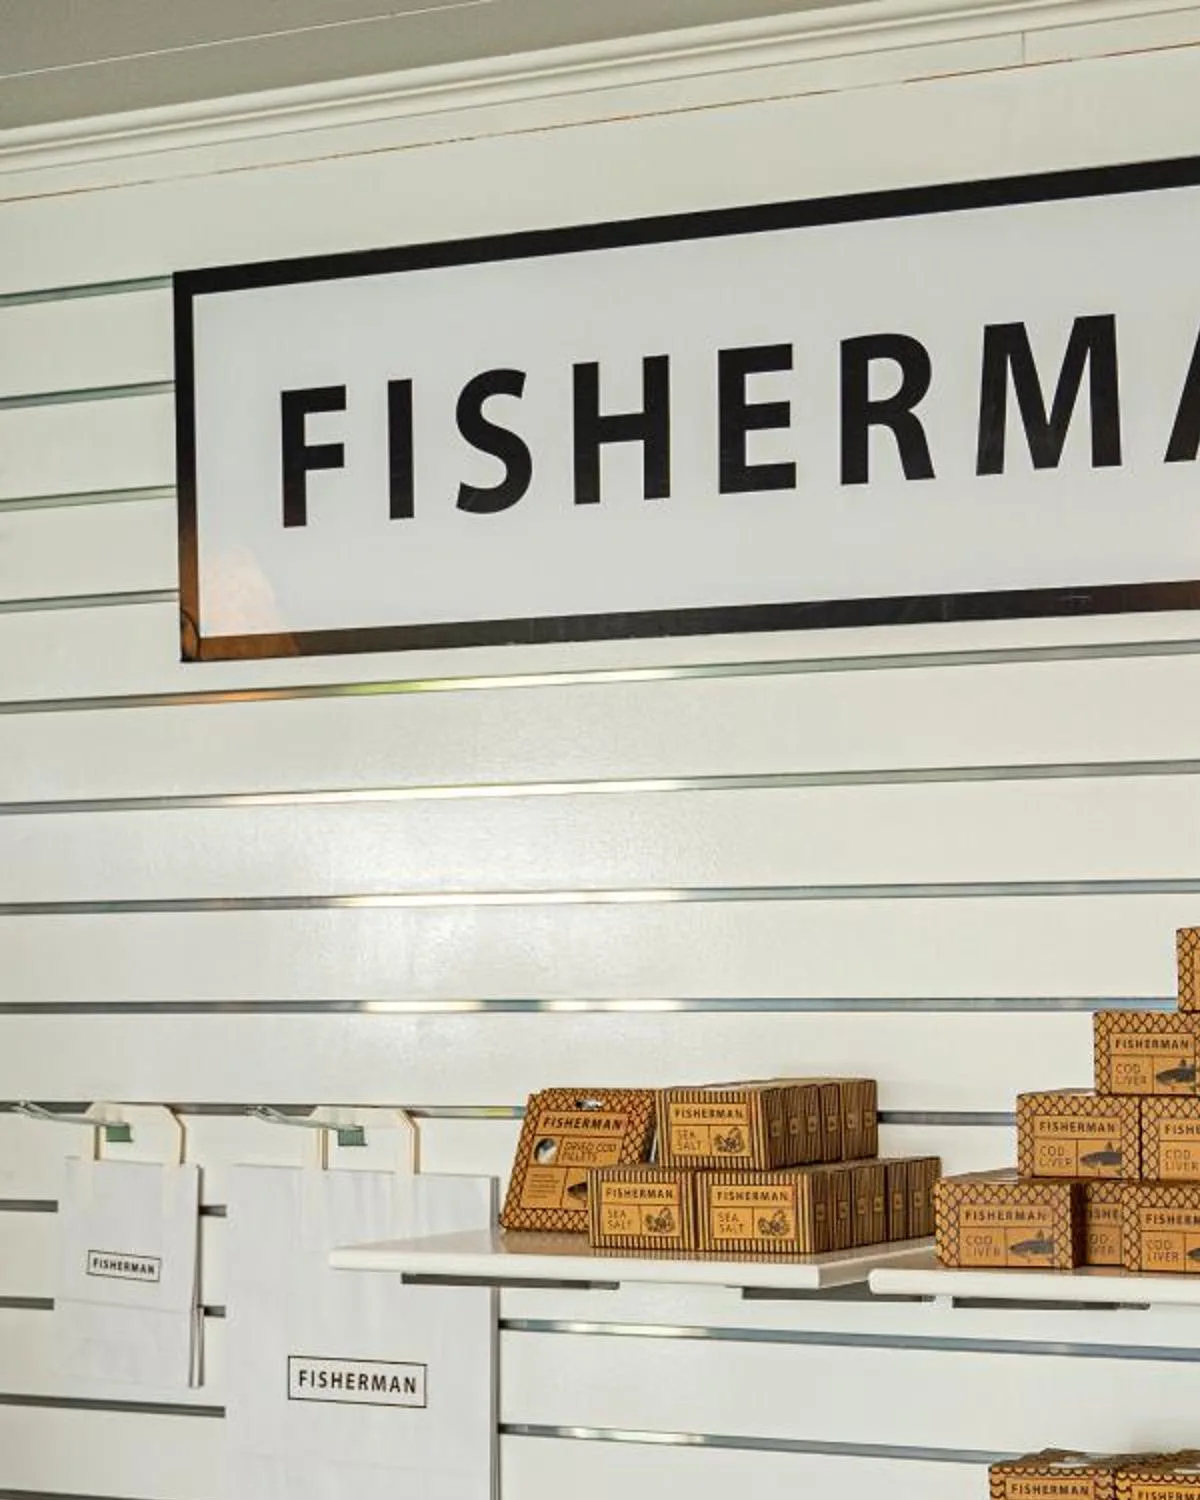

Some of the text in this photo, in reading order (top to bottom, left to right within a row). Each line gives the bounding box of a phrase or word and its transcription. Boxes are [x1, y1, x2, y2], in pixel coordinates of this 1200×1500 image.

[1115, 1039, 1189, 1049] FISHERMAN
[1115, 1063, 1141, 1074] COD
[675, 1108, 744, 1119] FISHERMAN
[543, 1116, 622, 1131] FISHERMAN
[1039, 1121, 1117, 1133] FISHERMAN
[677, 1129, 696, 1139] SEA
[677, 1140, 702, 1150] SALT
[1039, 1146, 1064, 1157] COD
[1165, 1150, 1192, 1160] COD
[605, 1188, 673, 1199] FISHERMAN
[717, 1190, 787, 1201] FISHERMAN
[607, 1209, 626, 1219] SEA
[719, 1212, 738, 1222] SEA
[964, 1210, 1047, 1221] FISHERMAN
[607, 1219, 632, 1230] SALT
[719, 1223, 744, 1234] SALT
[965, 1235, 993, 1246] COD
[1145, 1239, 1172, 1250] COD
[93, 1256, 156, 1276] FISHERMAN
[298, 1369, 418, 1395] FISHERMAN
[1010, 1483, 1090, 1496] FISHERMAN
